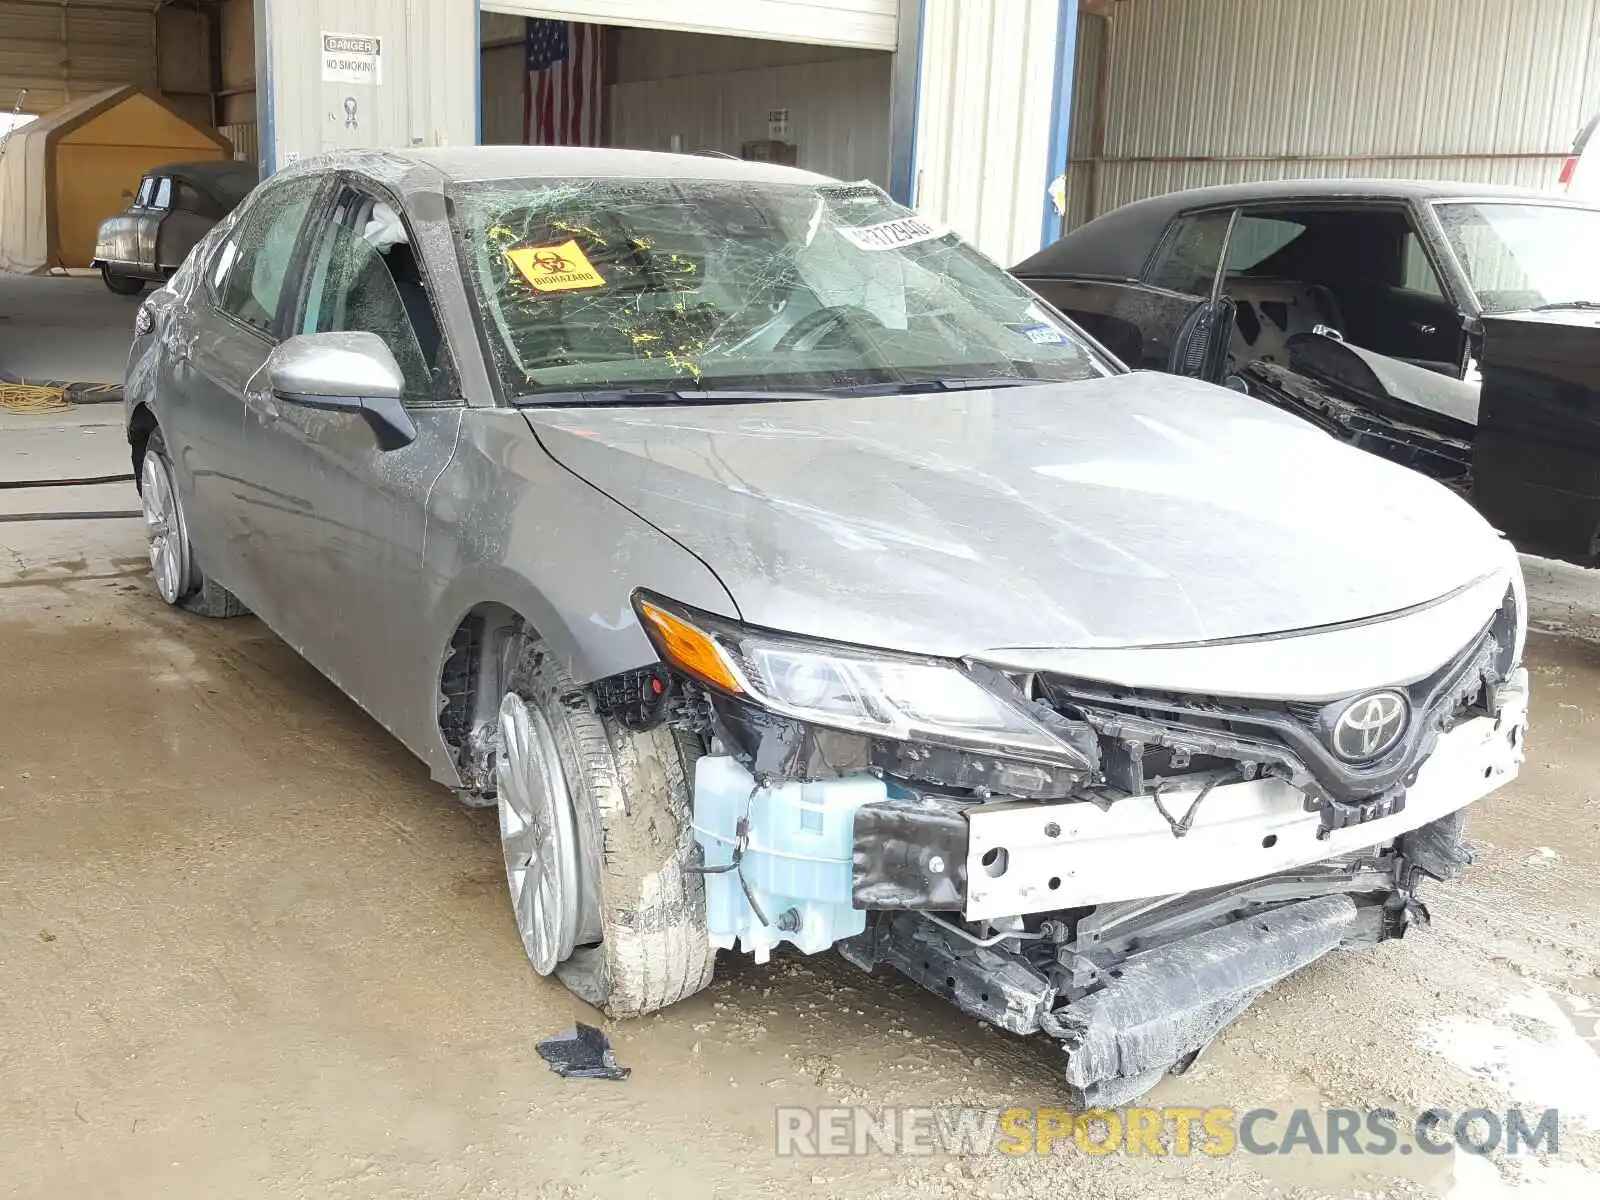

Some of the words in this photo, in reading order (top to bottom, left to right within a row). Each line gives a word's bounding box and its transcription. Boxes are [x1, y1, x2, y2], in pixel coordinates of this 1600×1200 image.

[329, 39, 372, 51] DANGER
[326, 59, 338, 70] NO
[339, 60, 376, 73] SMOKING
[533, 271, 594, 286] BIOHAZARD
